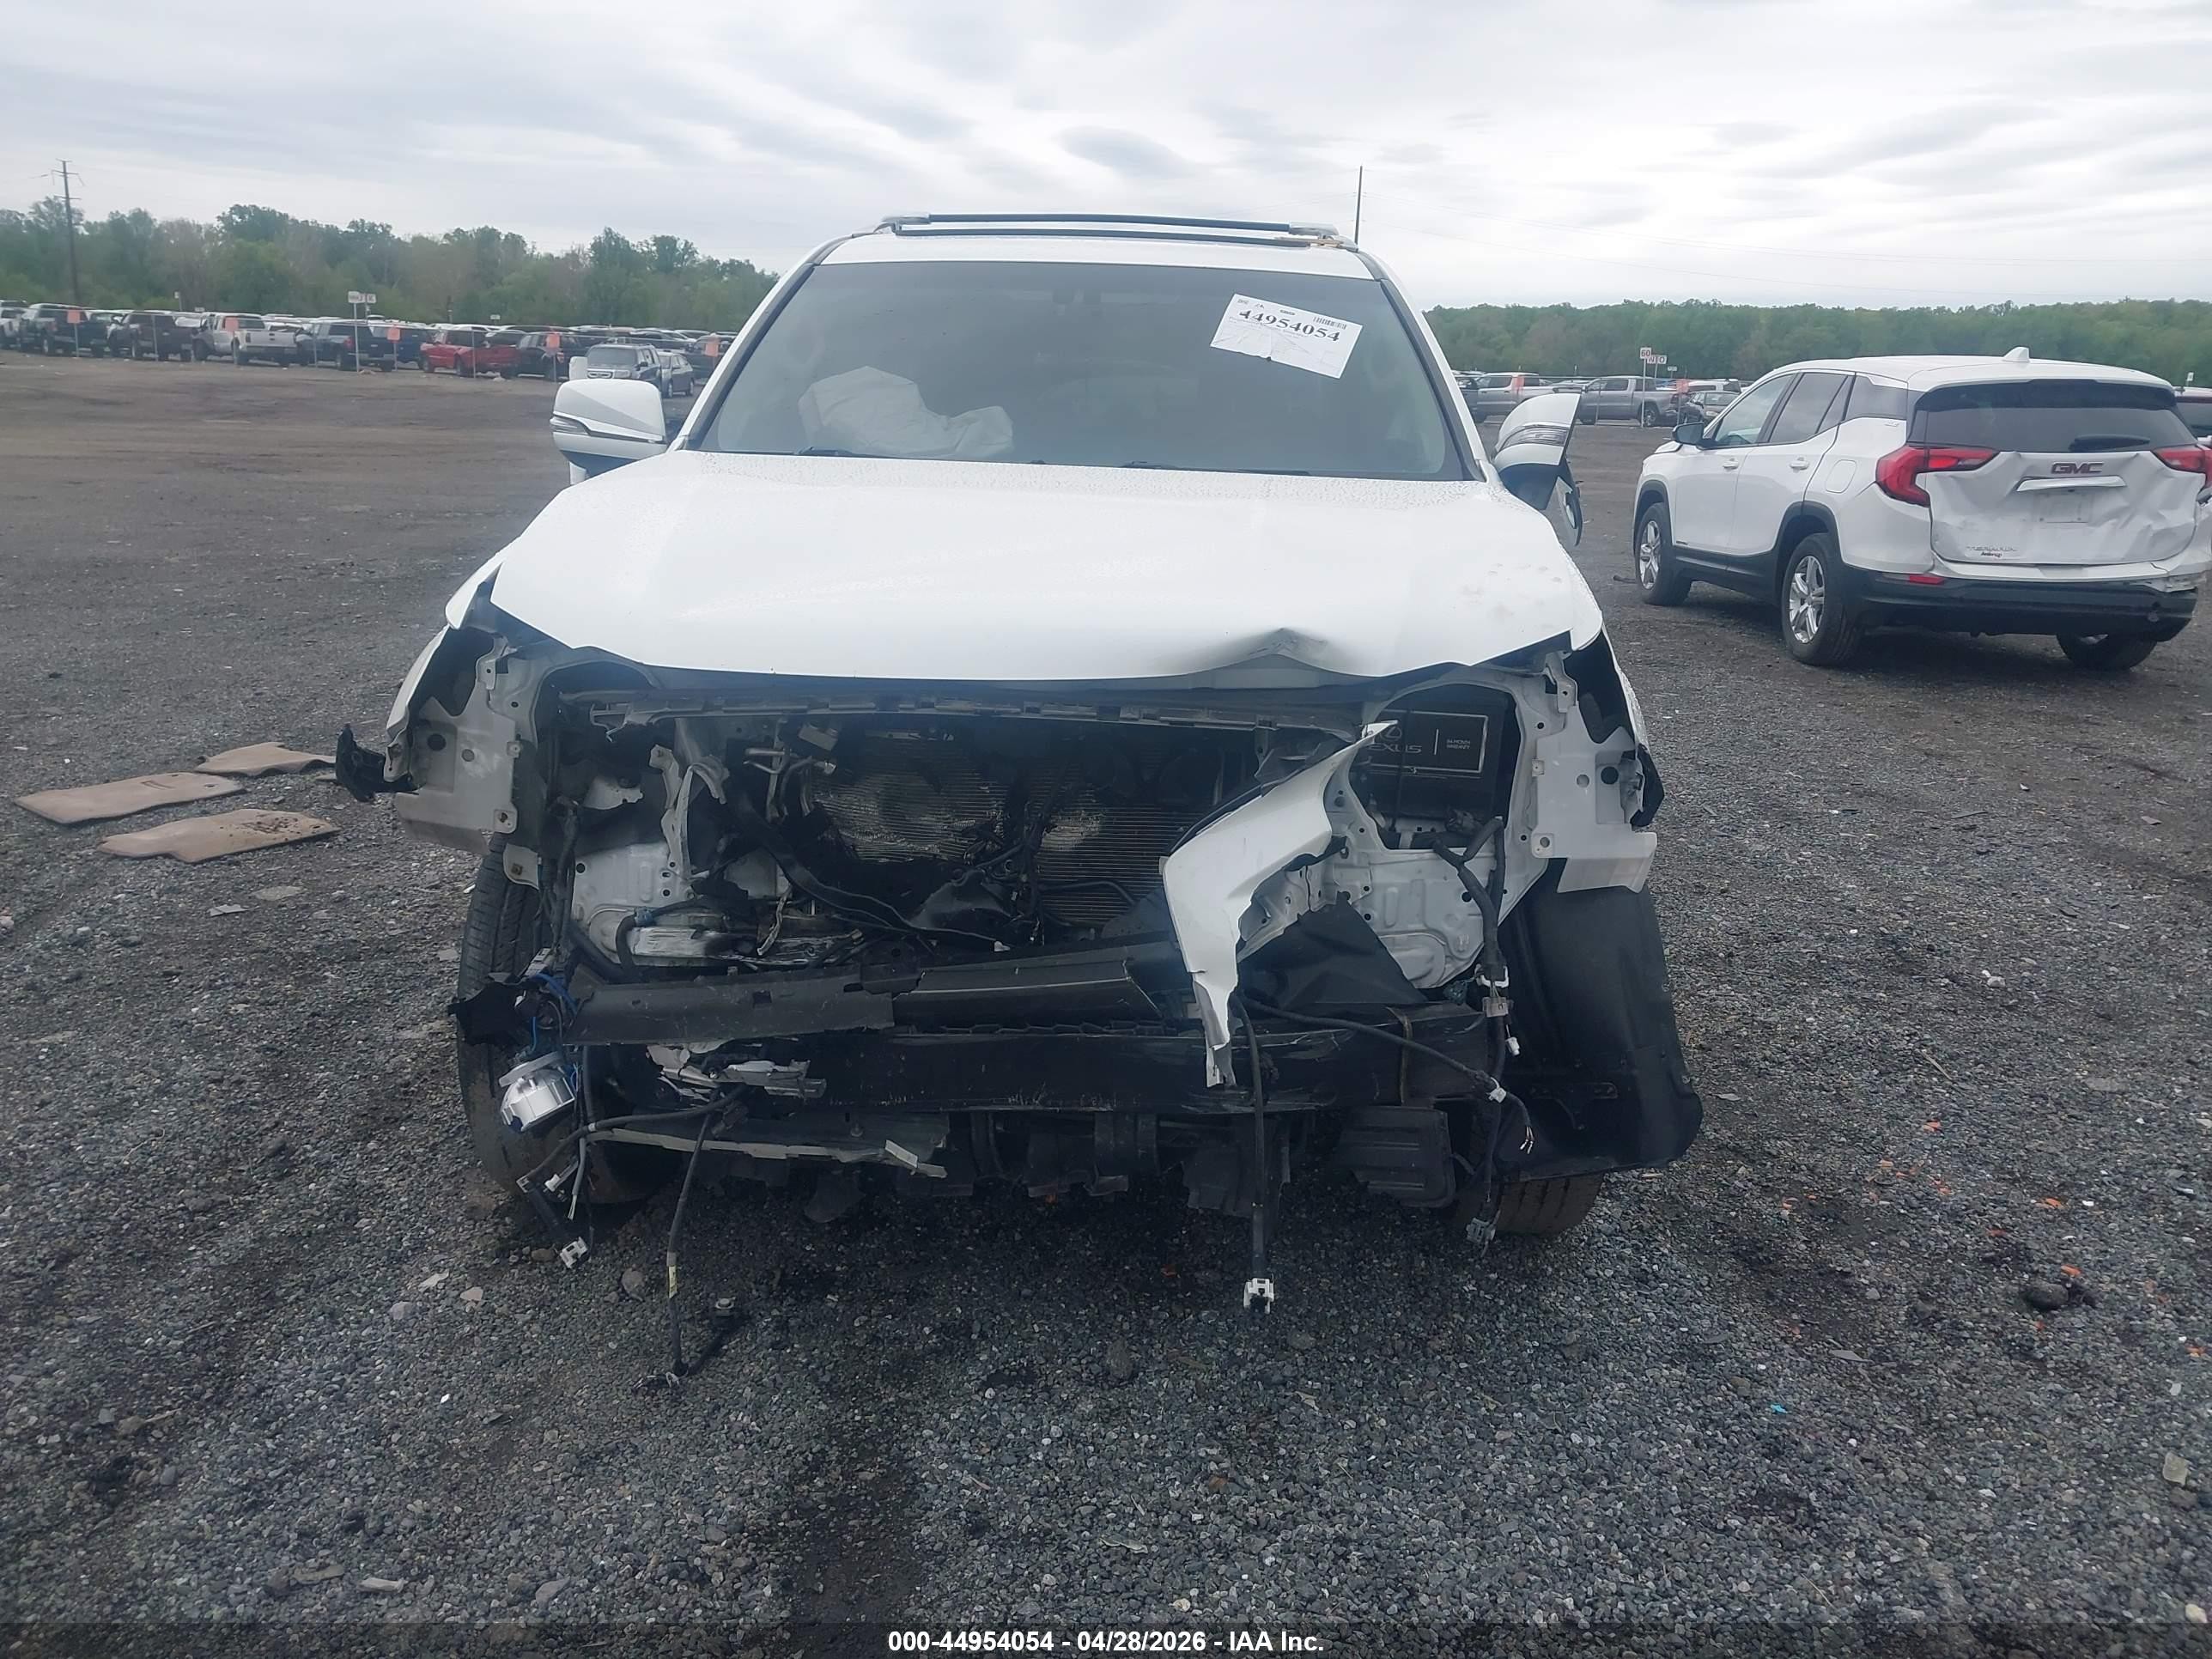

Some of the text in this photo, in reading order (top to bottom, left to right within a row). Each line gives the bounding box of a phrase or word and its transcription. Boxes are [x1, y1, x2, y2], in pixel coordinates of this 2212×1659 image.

[1238, 309, 1341, 342] 44954054
[2051, 461, 2105, 474] GMC
[1366, 742, 1423, 754] EXUS
